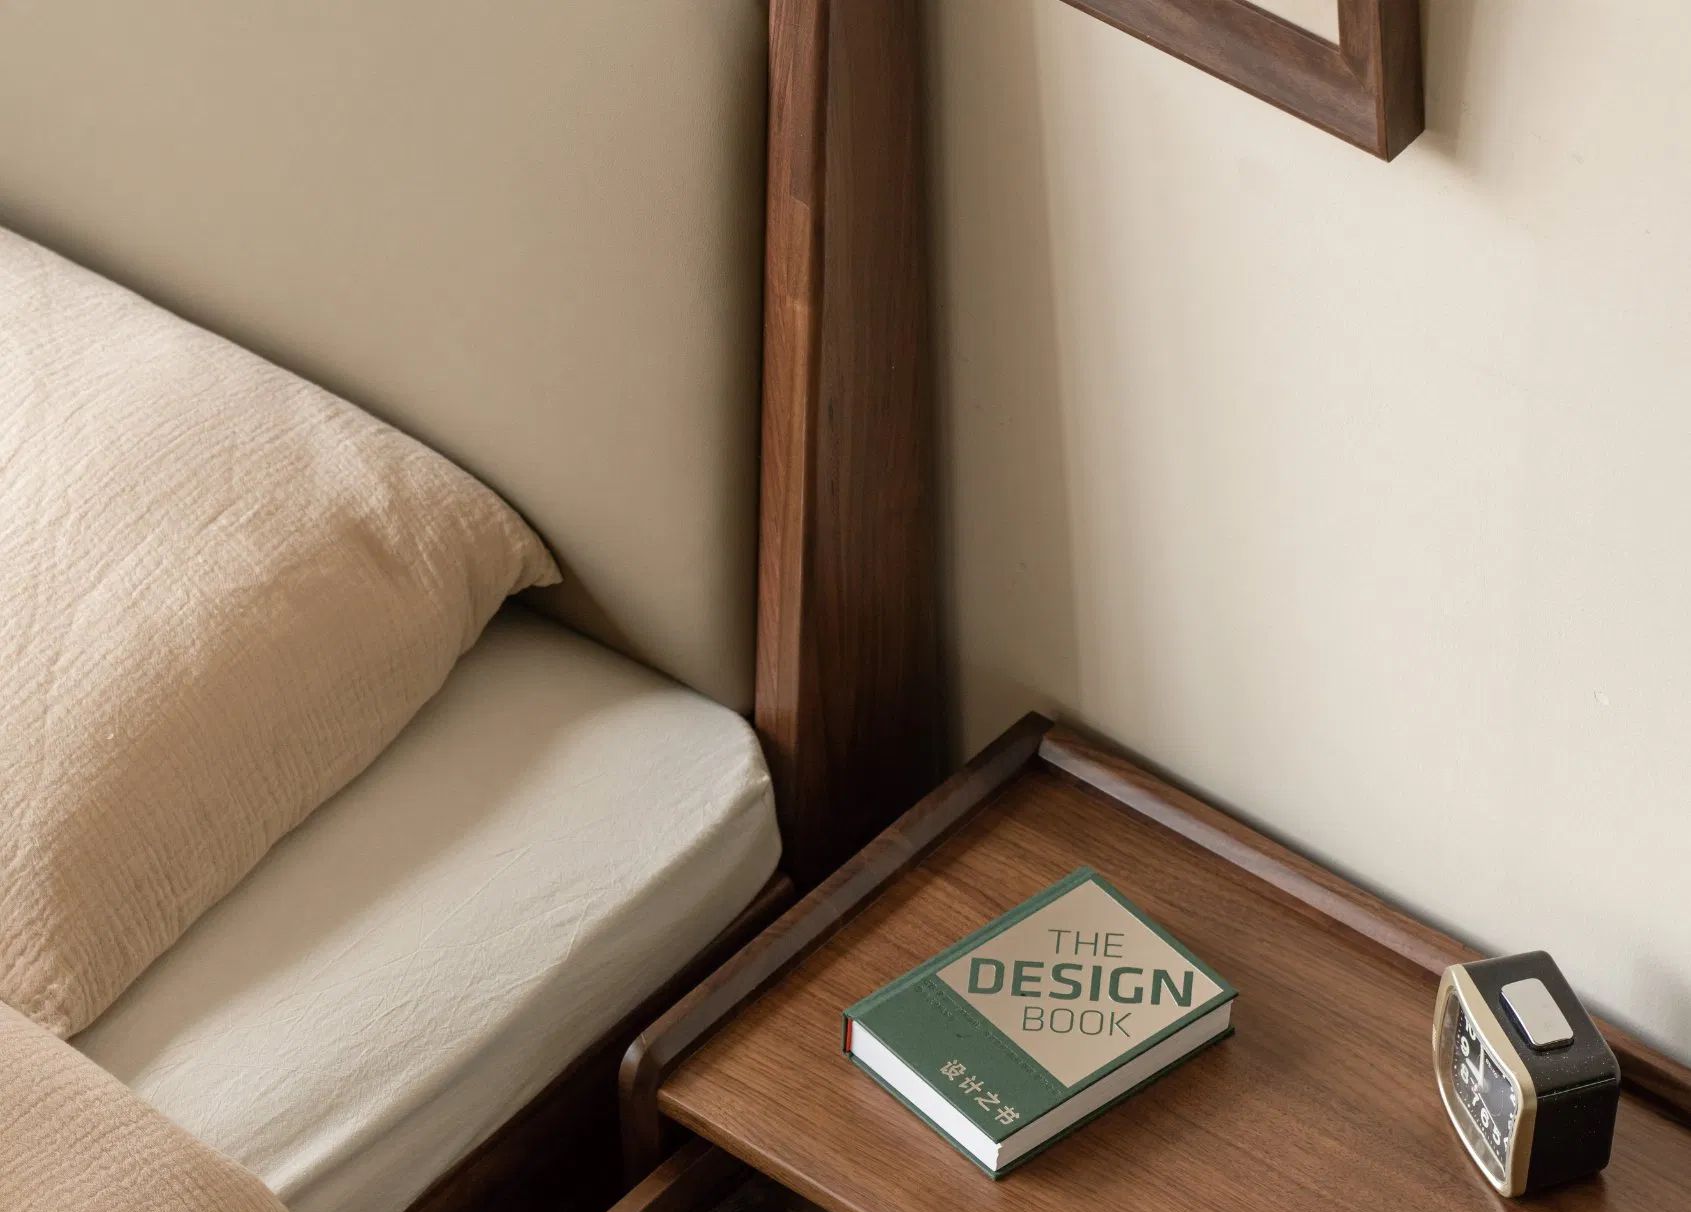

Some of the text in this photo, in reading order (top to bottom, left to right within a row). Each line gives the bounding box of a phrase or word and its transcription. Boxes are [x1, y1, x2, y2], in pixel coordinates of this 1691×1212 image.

[1048, 928, 1125, 958] THE
[967, 956, 1195, 1008] DESIGN
[1022, 1006, 1132, 1038] BOOK
[1460, 1035, 1470, 1057] 9
[1460, 1063, 1469, 1085] 8
[939, 1059, 1021, 1126] 设计之书
[1480, 1107, 1490, 1128] 6
[1492, 1125, 1502, 1146] 5
